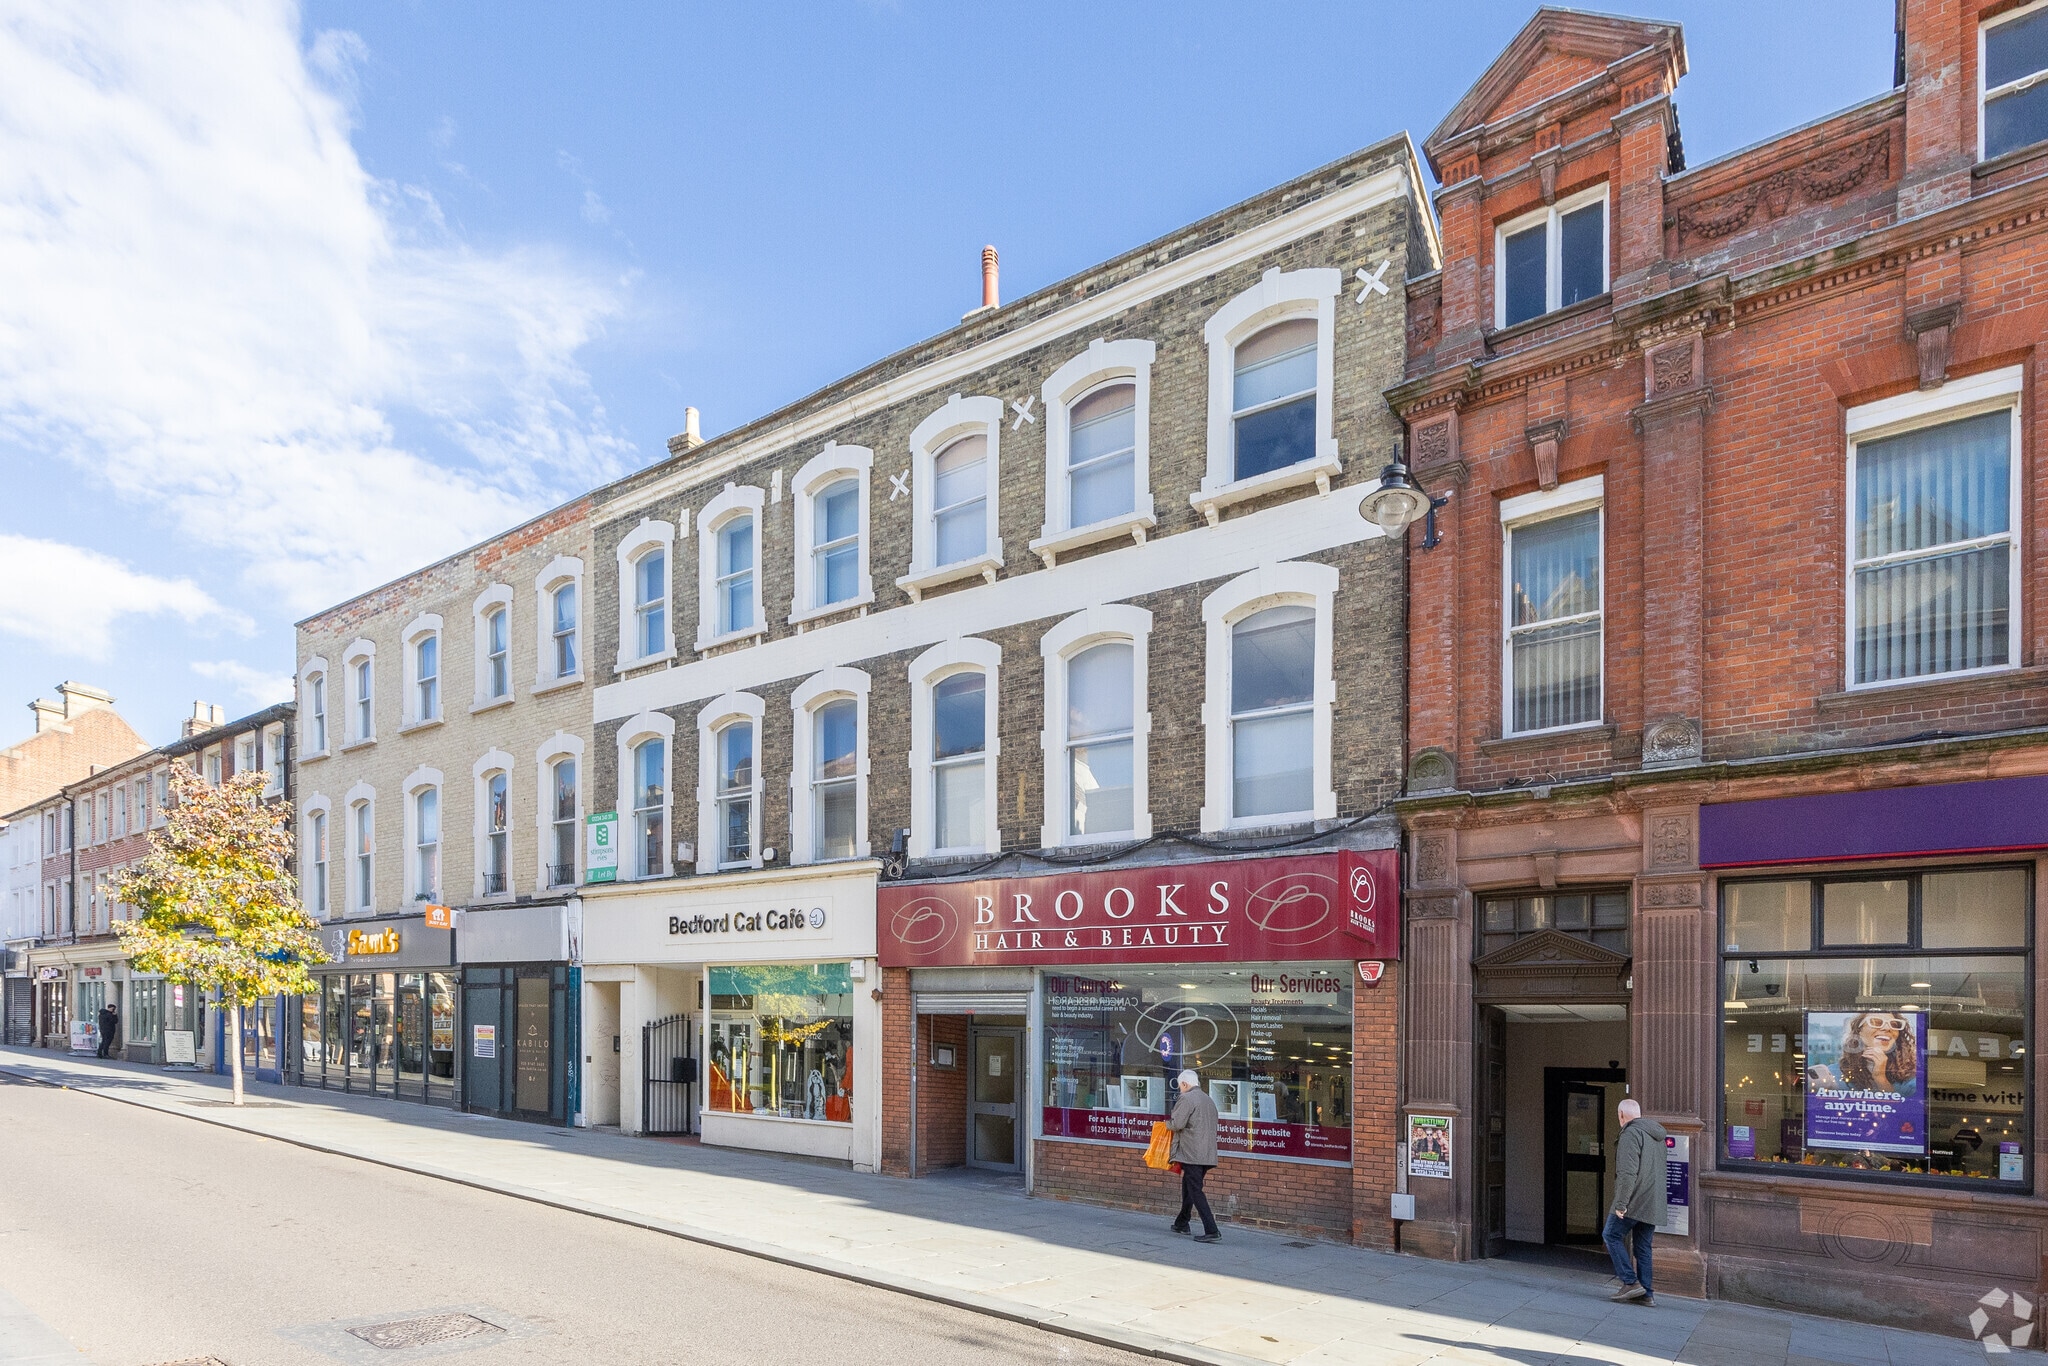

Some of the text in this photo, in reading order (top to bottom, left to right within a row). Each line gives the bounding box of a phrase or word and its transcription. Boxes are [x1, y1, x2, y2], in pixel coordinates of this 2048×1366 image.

[974, 880, 1230, 926] BROOKS
[669, 908, 805, 935] Bedford Cat Café
[1350, 909, 1375, 928] BROOKS
[347, 926, 401, 955] Sam's
[976, 925, 1227, 950] HAIR & BEAUTY
[1051, 976, 1119, 994] Our Courses
[1251, 973, 1341, 993] Our Services
[518, 1040, 549, 1048] KABILO
[1251, 1074, 1274, 1082] Barbering
[1815, 1087, 1906, 1103] Anywhere,
[1932, 1088, 1977, 1102] time
[1824, 1101, 1897, 1114] anytime.
[1414, 1117, 1446, 1126] WRESTLING
[1108, 1126, 1128, 1134] 291309
[1216, 1124, 1228, 1132] list
[1230, 1125, 1245, 1134] visit
[1260, 1128, 1291, 1138] website
